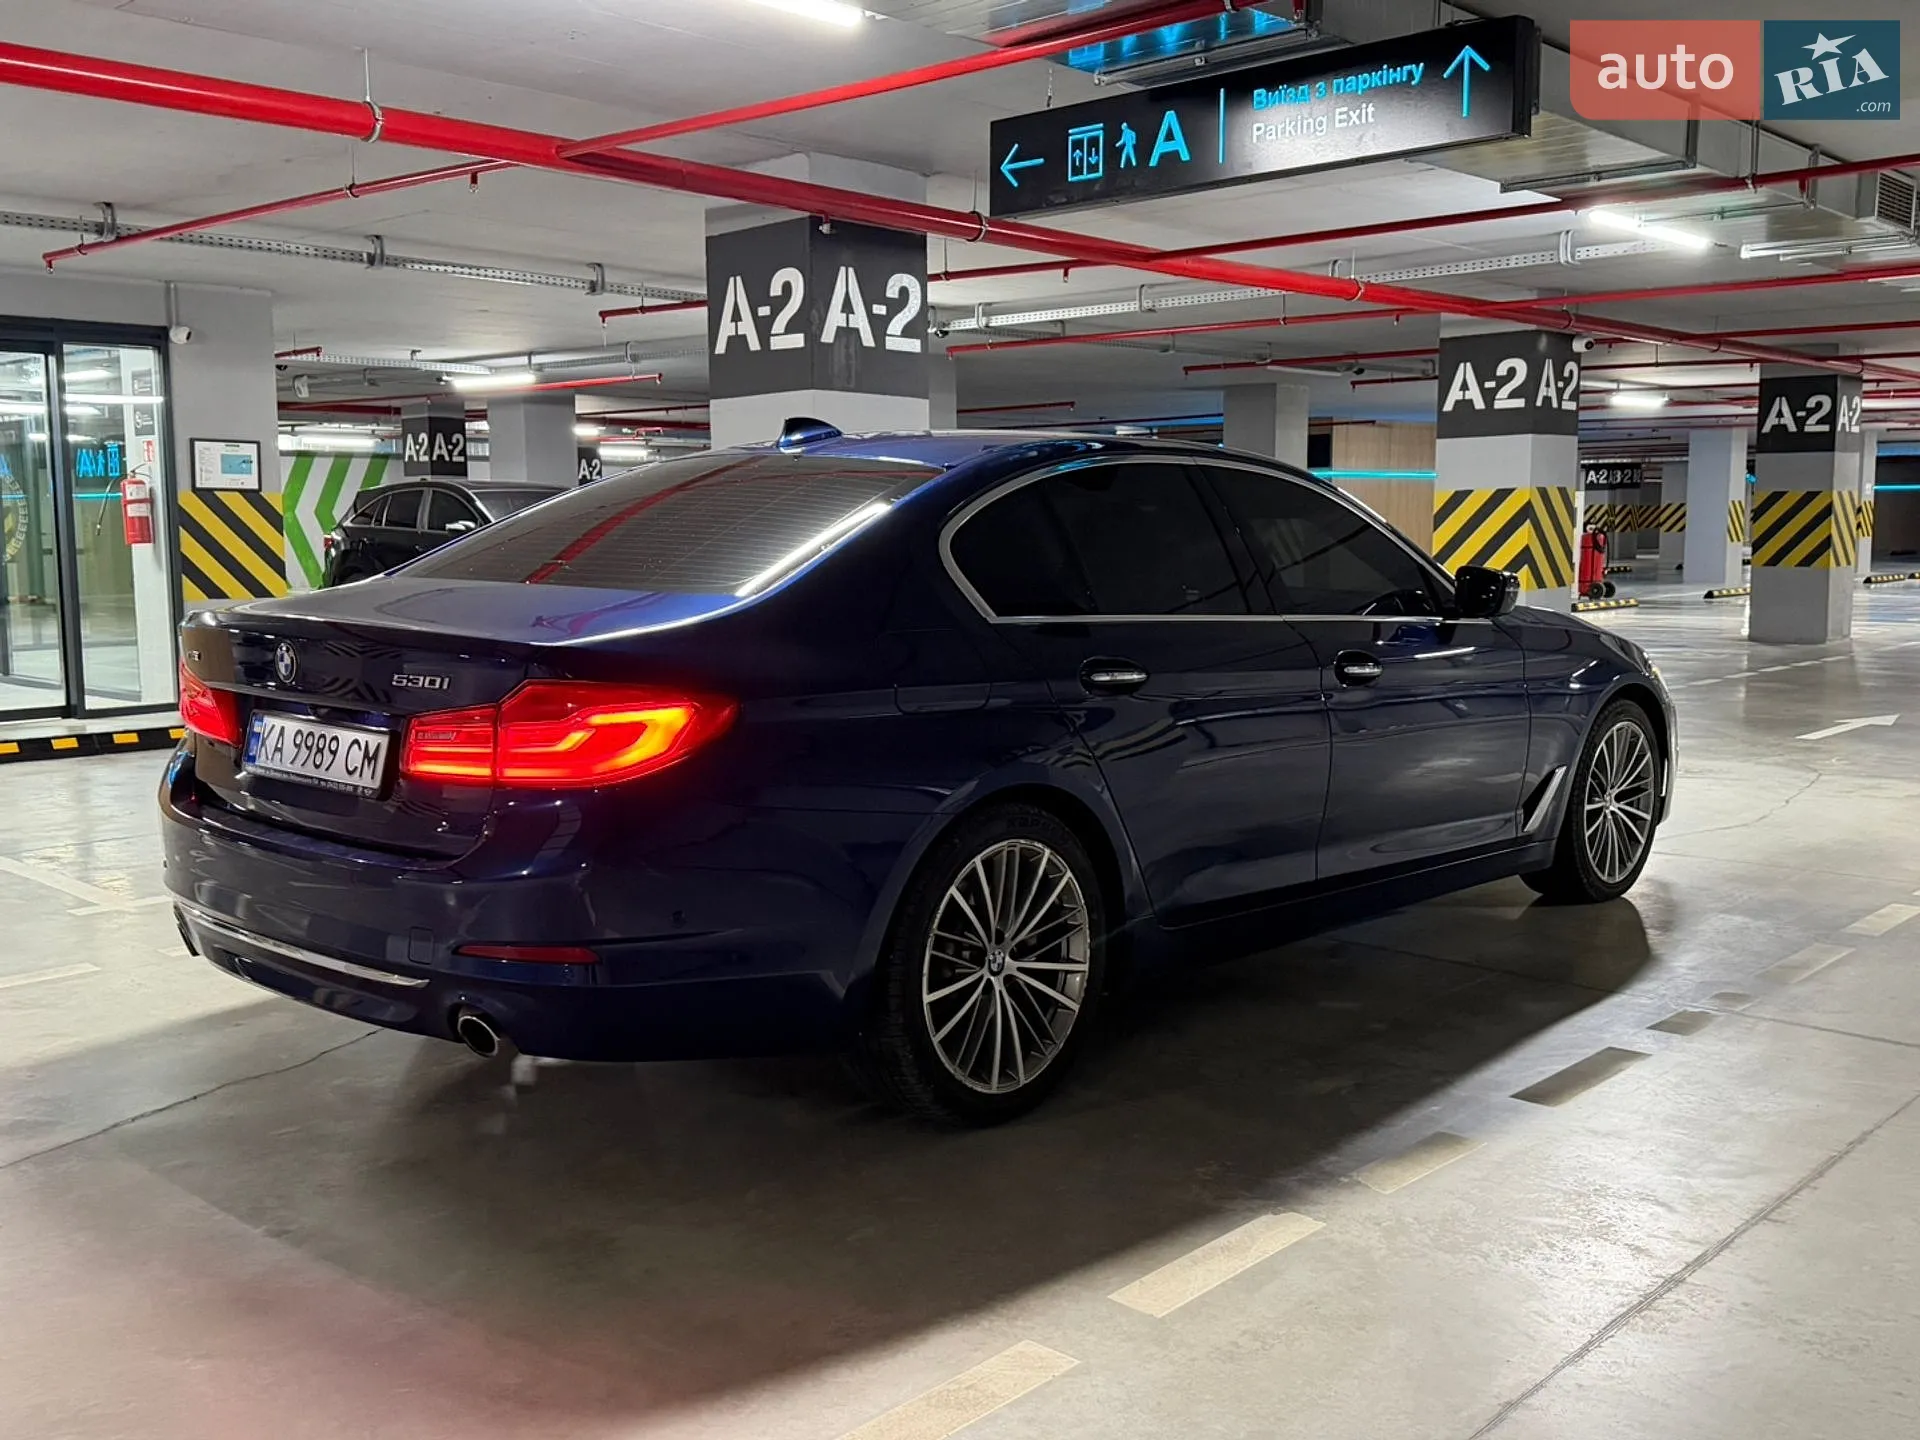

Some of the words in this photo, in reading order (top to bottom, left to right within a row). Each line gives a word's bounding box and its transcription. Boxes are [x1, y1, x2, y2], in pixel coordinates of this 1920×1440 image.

[1252, 82, 1311, 111] Виїзд
[1315, 82, 1327, 99] з
[1332, 61, 1425, 97] паркінгу
[1148, 109, 1192, 168] A
[1251, 111, 1328, 144] Parking
[1334, 102, 1376, 130] Exit
[714, 266, 806, 355] A-2
[819, 265, 923, 354] A-2
[1441, 357, 1529, 413] A-2
[1535, 358, 1580, 412] A-2
[1760, 393, 1833, 434] A-2
[1837, 395, 1861, 434] A-2
[404, 432, 430, 463] A-2
[432, 432, 466, 463] A-2
[578, 457, 602, 481] A-2
[1586, 468, 1608, 484] A-2
[257, 722, 286, 764] KA
[288, 728, 341, 772] 9989
[344, 737, 382, 781] CM
